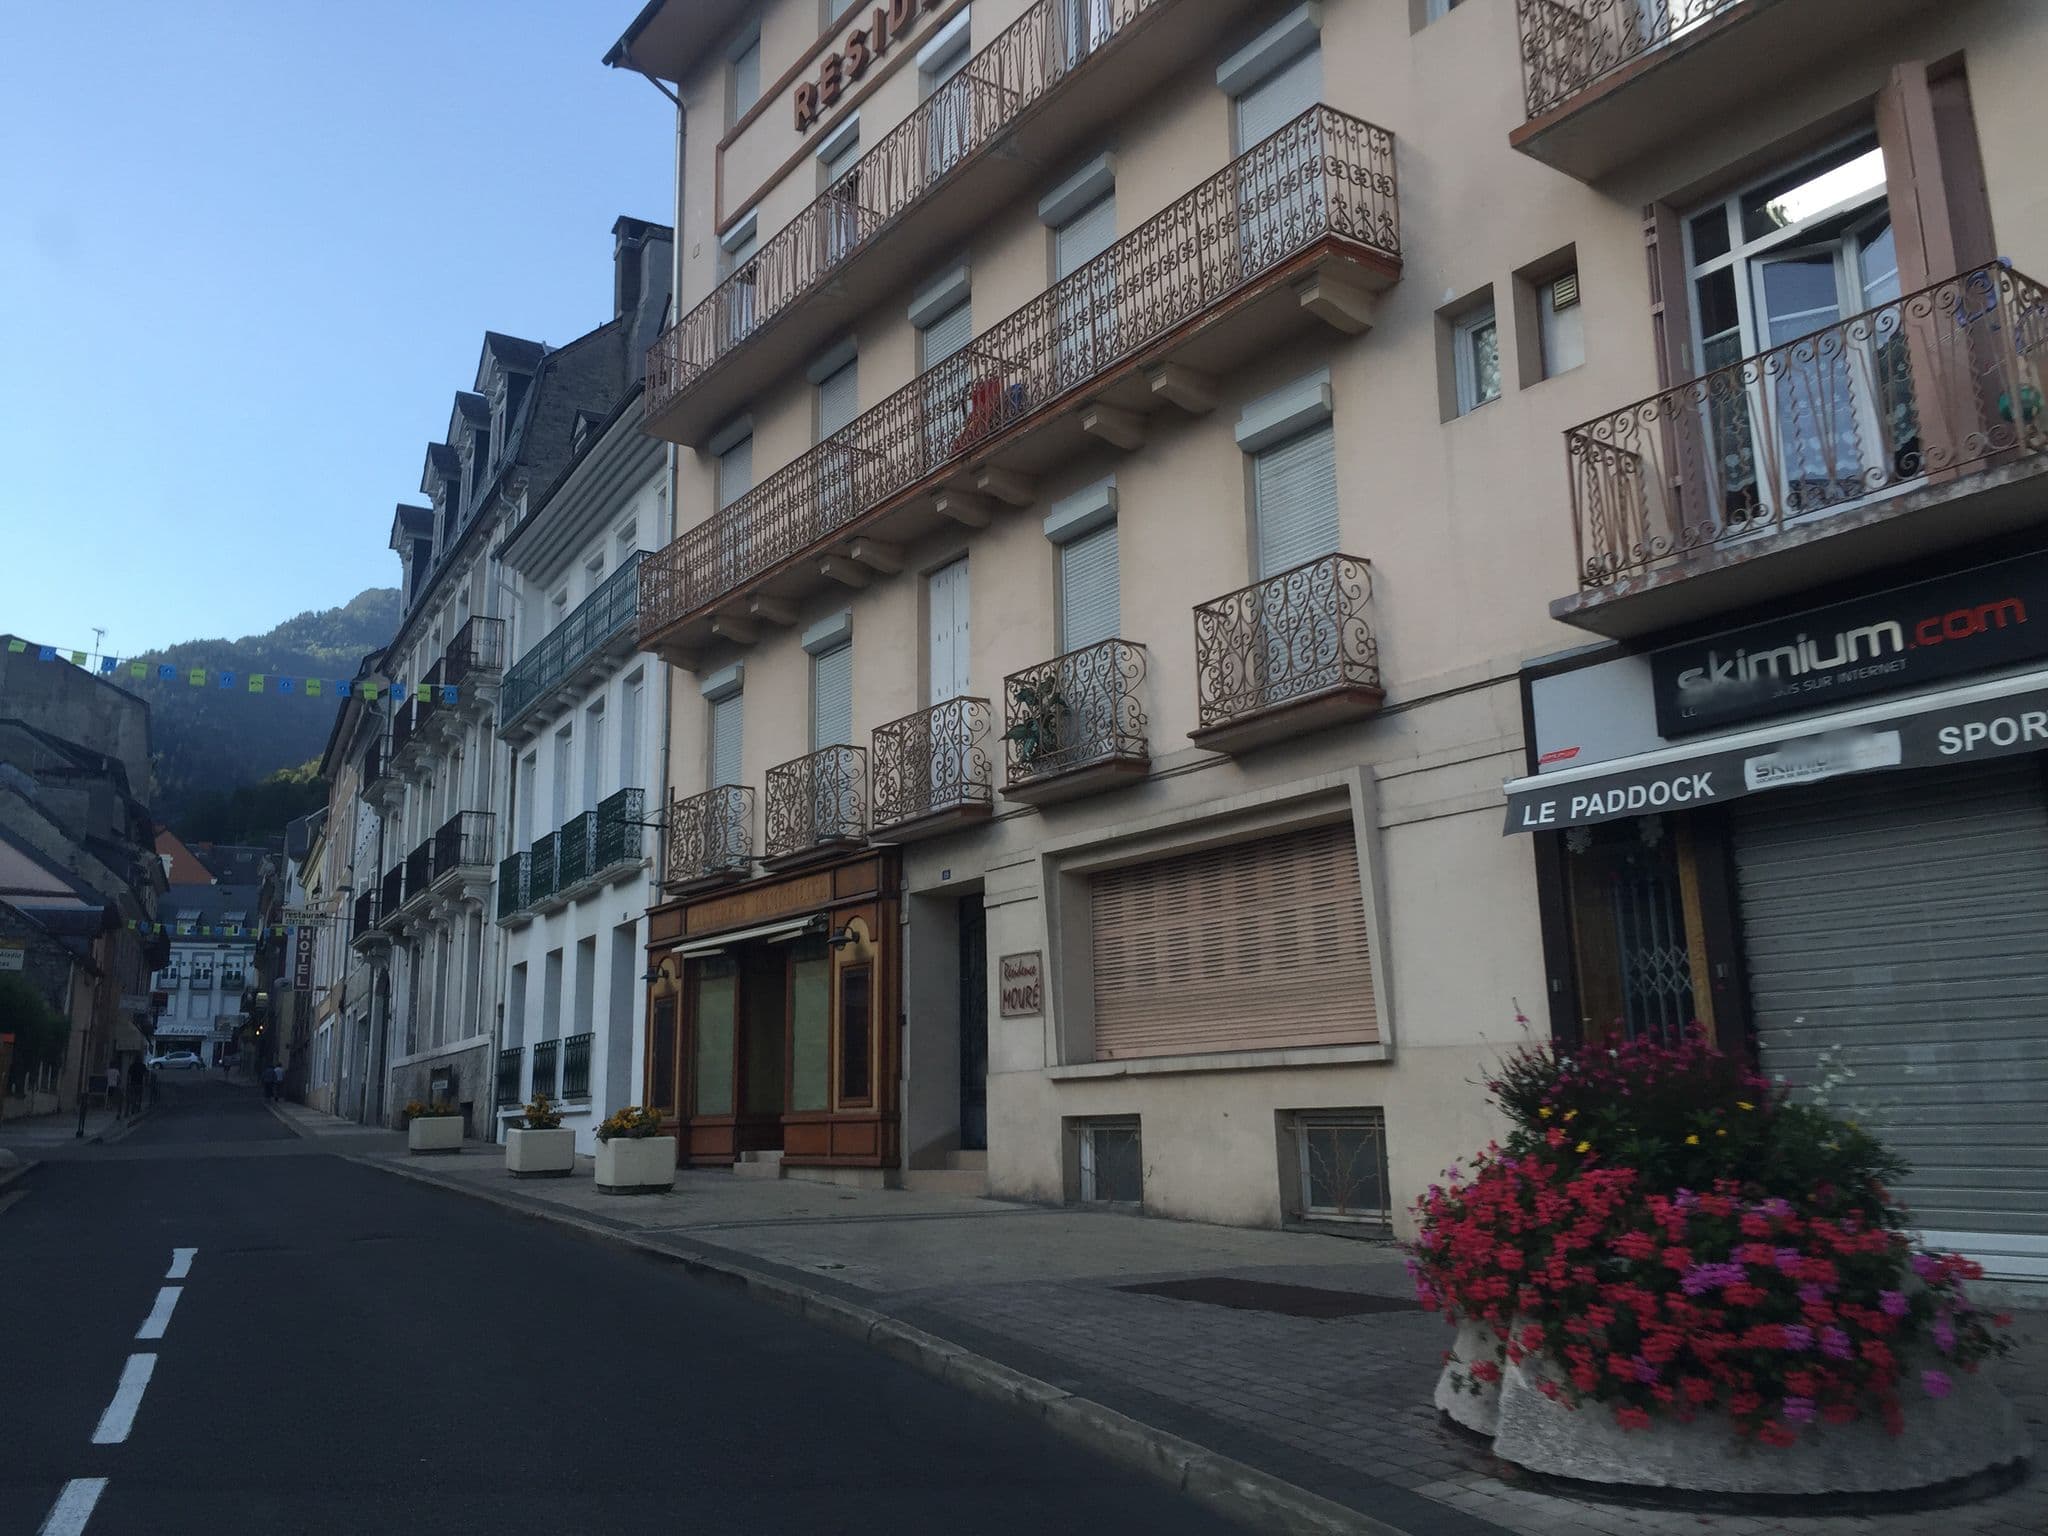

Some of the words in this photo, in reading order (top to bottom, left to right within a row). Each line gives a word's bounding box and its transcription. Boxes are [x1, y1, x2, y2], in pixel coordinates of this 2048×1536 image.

[793, 0, 938, 134] RESID
[1802, 675, 1833, 691] SUR
[1837, 658, 1908, 684] INTERNET
[1938, 709, 2048, 756] SPOR
[1522, 801, 1556, 827] LE
[1570, 771, 1715, 820] PADDOCK
[296, 928, 311, 987] HOTEL
